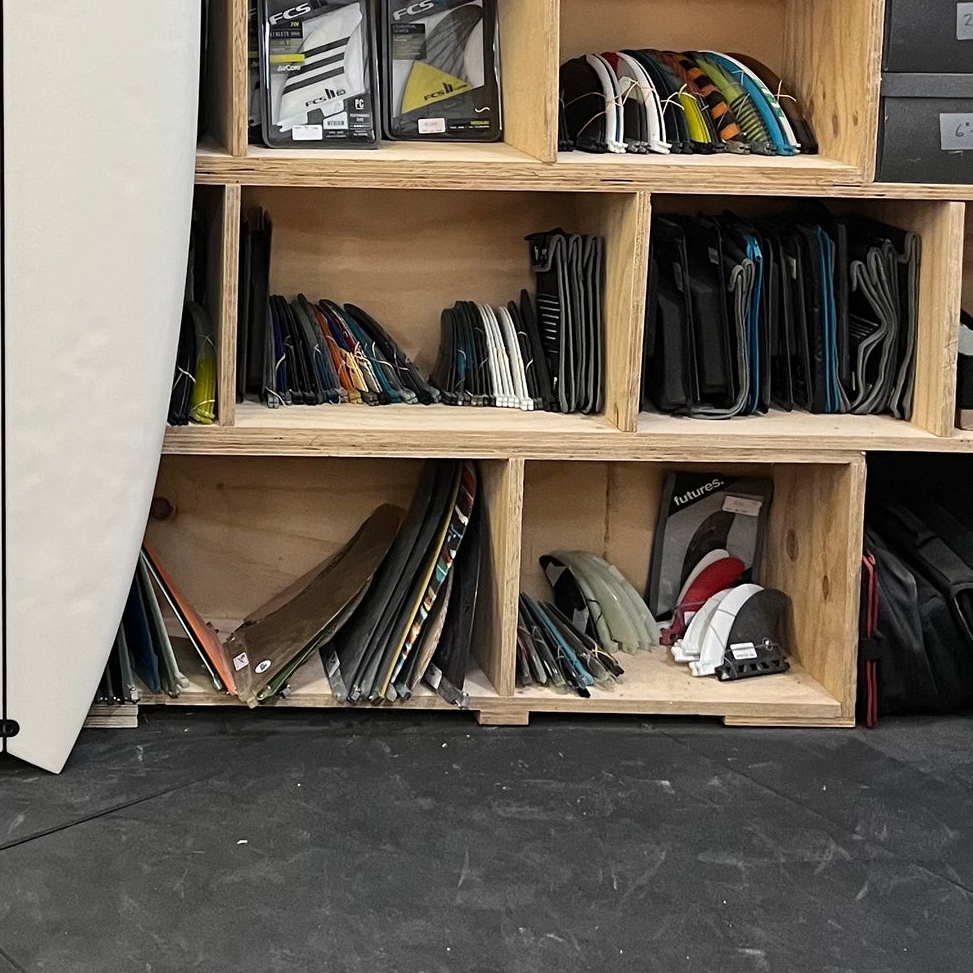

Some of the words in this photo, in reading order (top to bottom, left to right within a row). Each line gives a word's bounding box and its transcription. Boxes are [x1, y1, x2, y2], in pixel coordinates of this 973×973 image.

[269, 3, 311, 25] FCS
[424, 90, 445, 101] FCS
[674, 478, 724, 506] futures.
